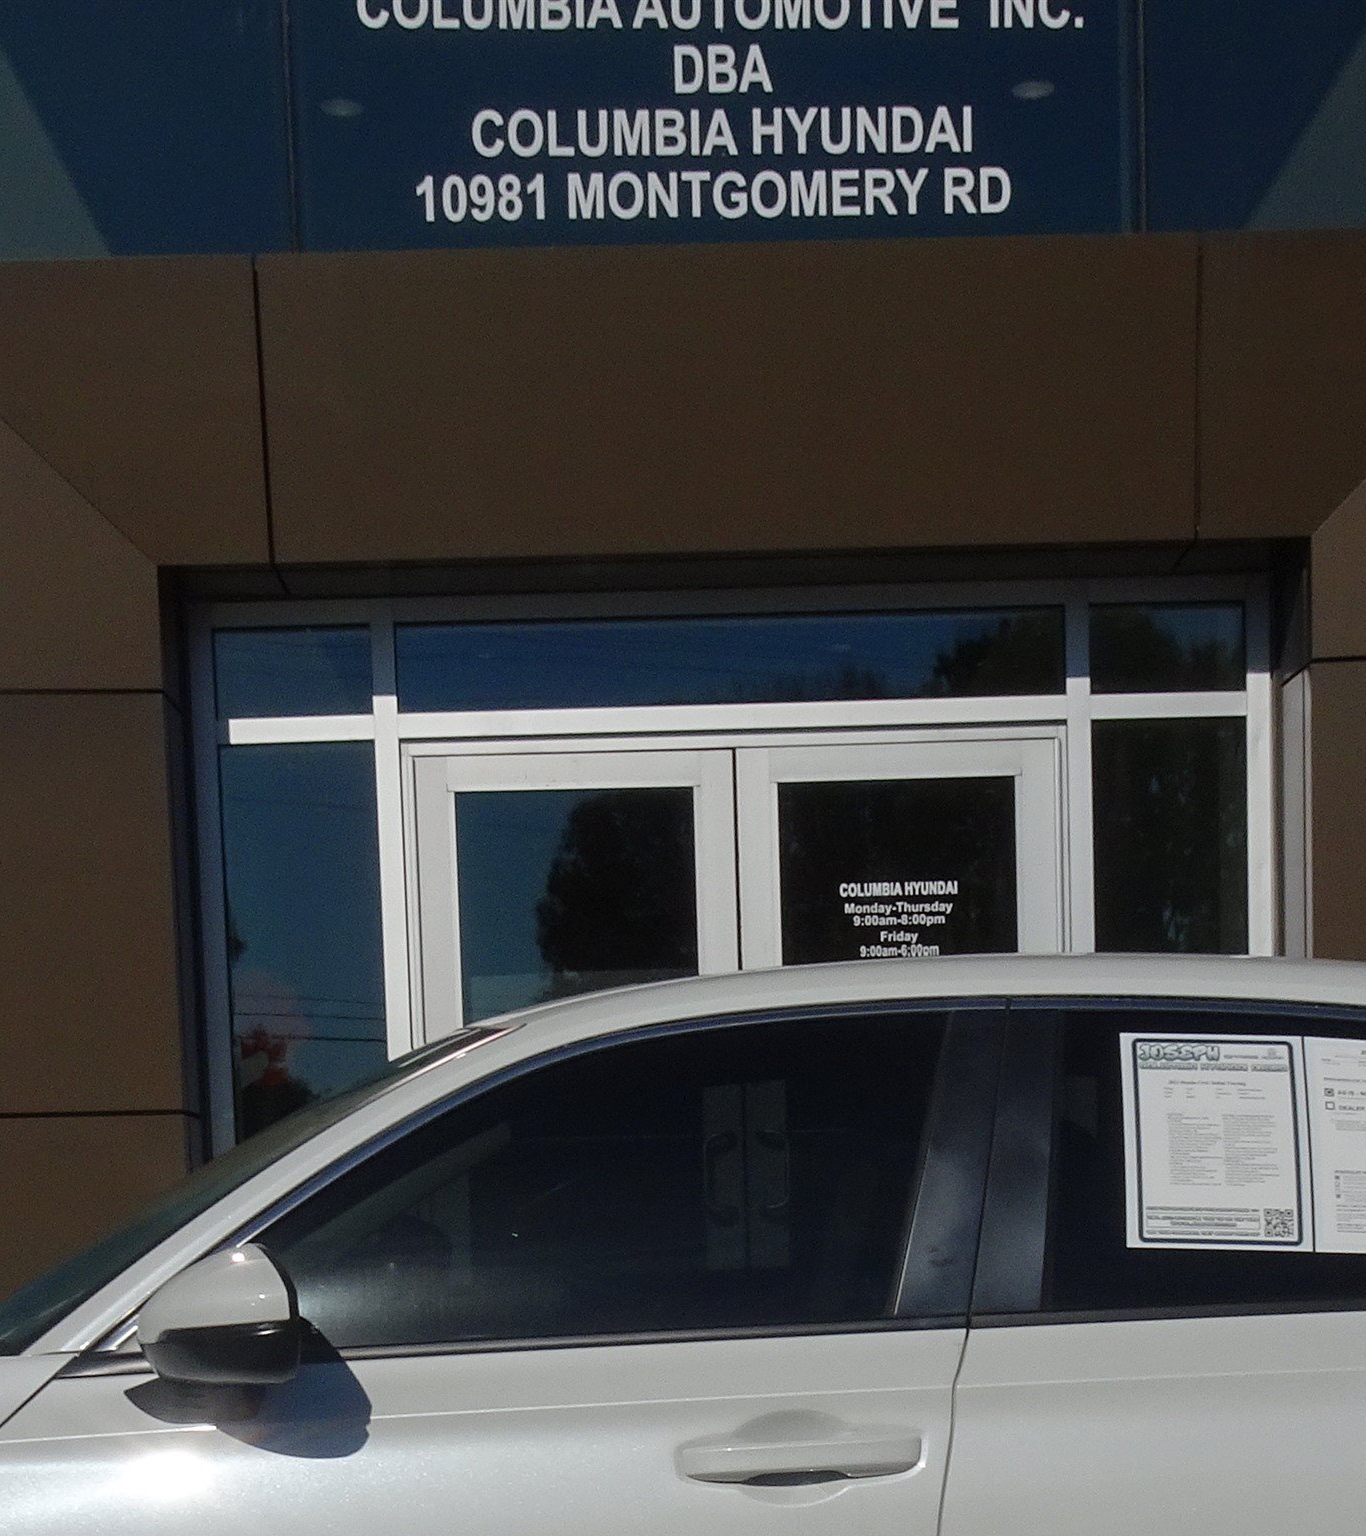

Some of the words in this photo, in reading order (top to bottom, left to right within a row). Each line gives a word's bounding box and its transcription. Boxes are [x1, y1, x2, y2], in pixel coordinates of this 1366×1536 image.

[673, 44, 773, 94] DBA
[471, 109, 738, 158] COLUMBIA
[752, 106, 973, 155] HYUNDAI
[415, 173, 547, 223] 10981
[567, 168, 930, 220] MONTGOMERY
[944, 166, 1011, 214] RD
[839, 882, 903, 897] COLUMBIA
[904, 880, 958, 896] HYUNDAI
[844, 901, 954, 915] Monday-Thursday
[853, 914, 946, 927] 9:00am-8:00pm
[880, 930, 919, 943] Friday
[1138, 1043, 1220, 1062] JOSEPH
